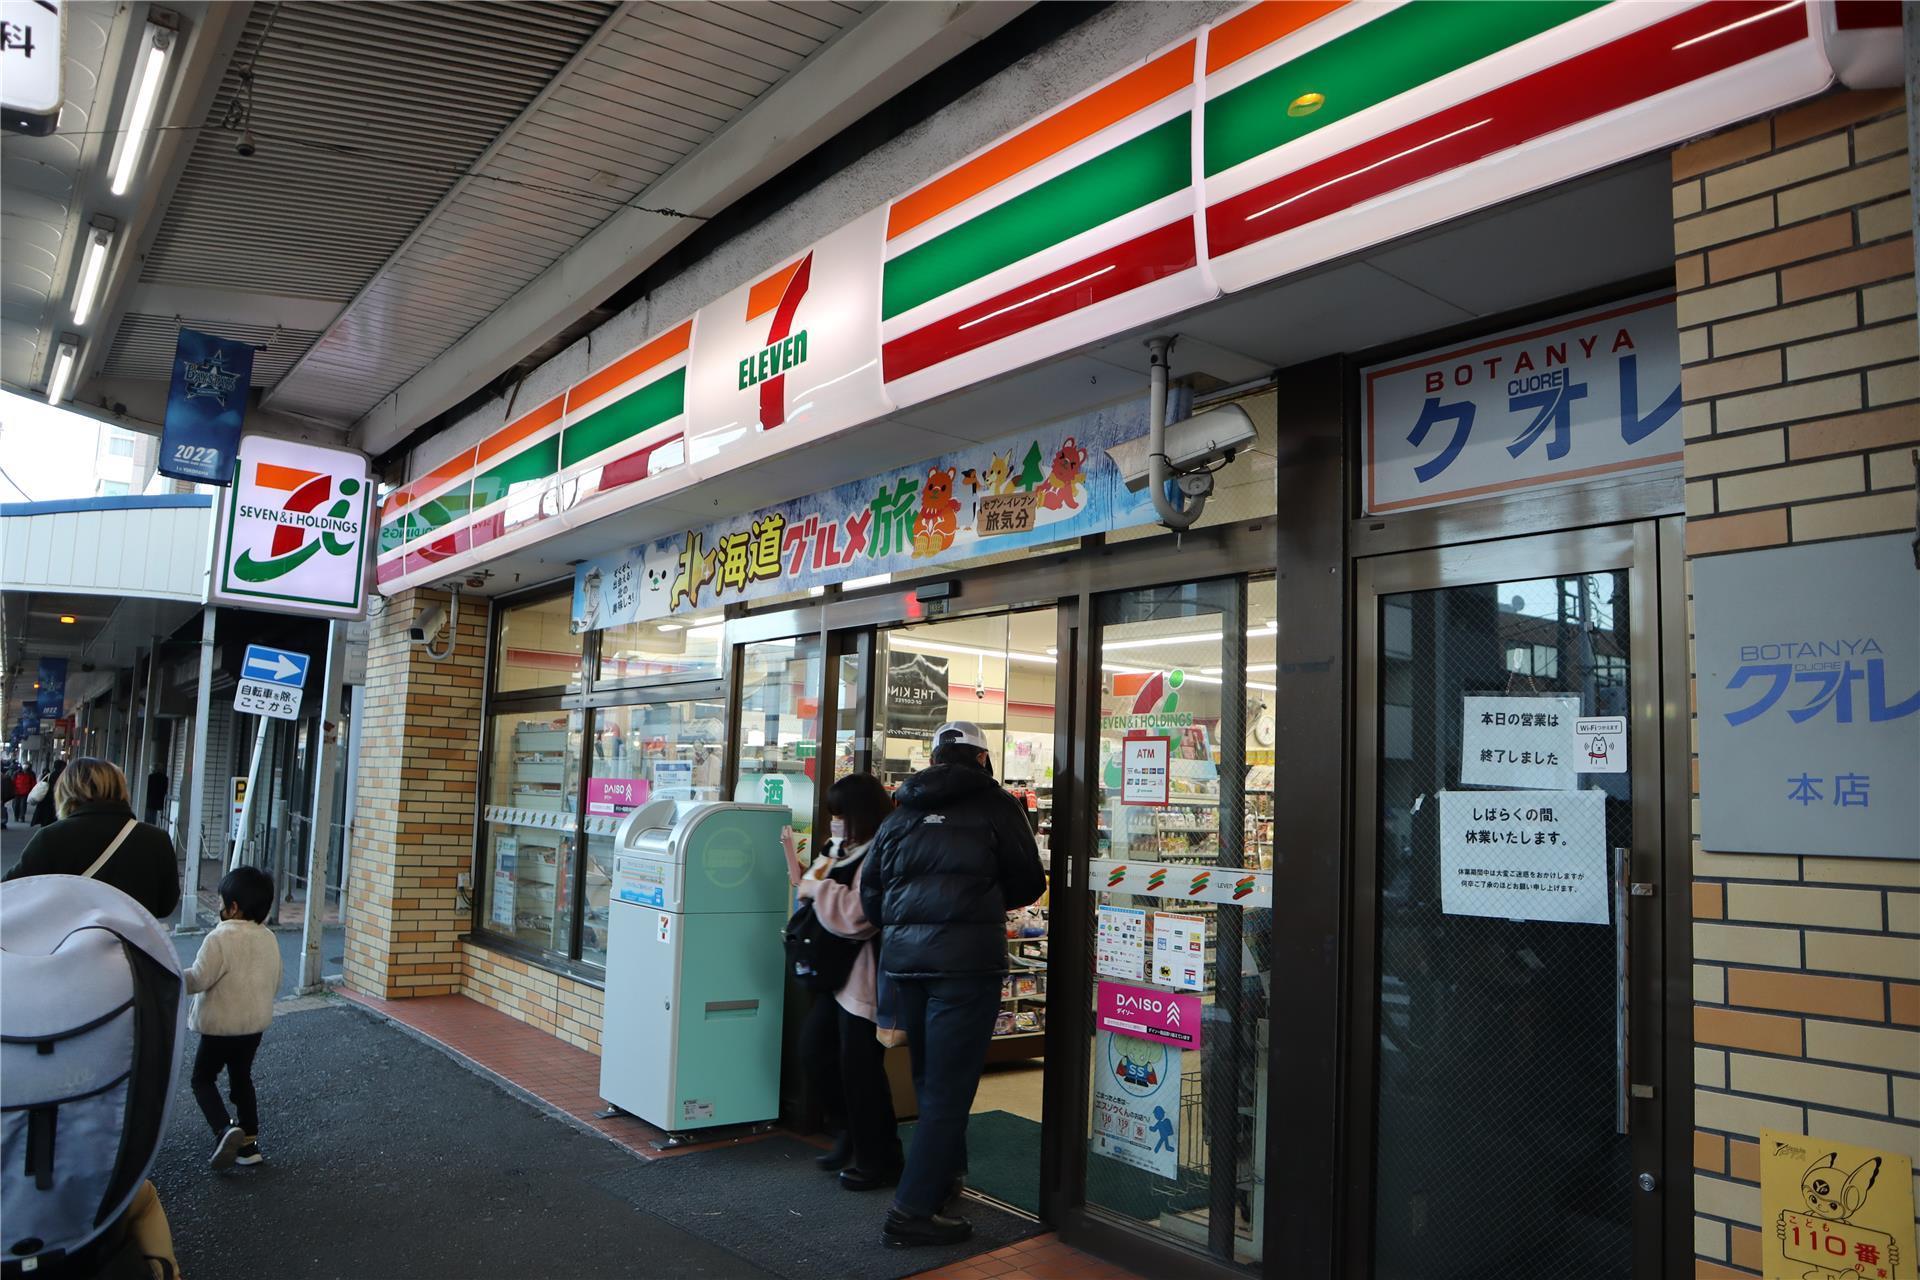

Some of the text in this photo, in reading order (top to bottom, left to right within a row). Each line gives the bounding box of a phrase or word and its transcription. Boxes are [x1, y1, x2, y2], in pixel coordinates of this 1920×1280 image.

[1425, 328, 1635, 393] BOTANYA
[1507, 369, 1563, 397] CUORE
[174, 444, 219, 464] 2022
[296, 514, 359, 534] HOLDINGS
[985, 508, 1030, 531] 旅気分
[670, 477, 920, 613] 北海道グルメ旅
[1740, 637, 1884, 662] BOTANYA
[1794, 661, 1842, 672] CUORE
[240, 684, 298, 704] 自転車を除く
[240, 697, 293, 715] ここから
[1480, 711, 1560, 728] 本日の営業は
[1136, 748, 1155, 759] ATM
[1479, 748, 1559, 766] 終了しました
[603, 783, 626, 795] DAISO
[1786, 772, 1871, 808] 本店
[1472, 806, 1560, 823] しばらくの間、
[1465, 829, 1568, 847] 休業いたします。
[1116, 993, 1163, 1013] DAISO
[1116, 1008, 1135, 1016] ダイソー
[1128, 1063, 1145, 1077] SS
[1789, 1215, 1830, 1233] こども
[1792, 1226, 1881, 1266] 110番
